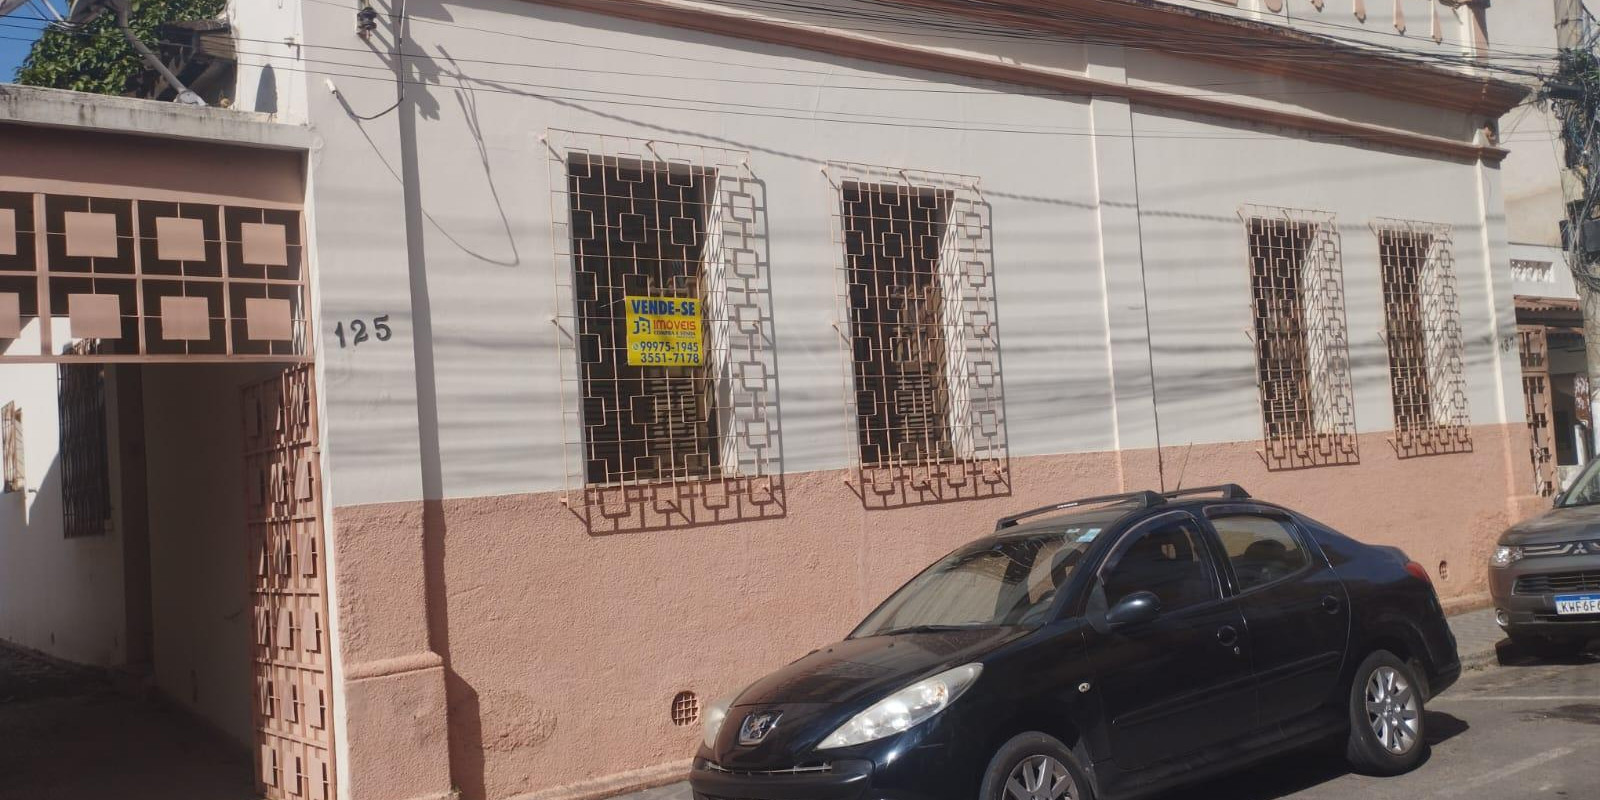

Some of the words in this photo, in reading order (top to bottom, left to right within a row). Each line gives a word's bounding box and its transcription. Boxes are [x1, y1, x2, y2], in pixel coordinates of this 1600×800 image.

[631, 300, 695, 315] VENDE-SE
[334, 314, 392, 349] 125
[640, 341, 698, 351] 99975-1945
[641, 353, 699, 363] 3551-7178
